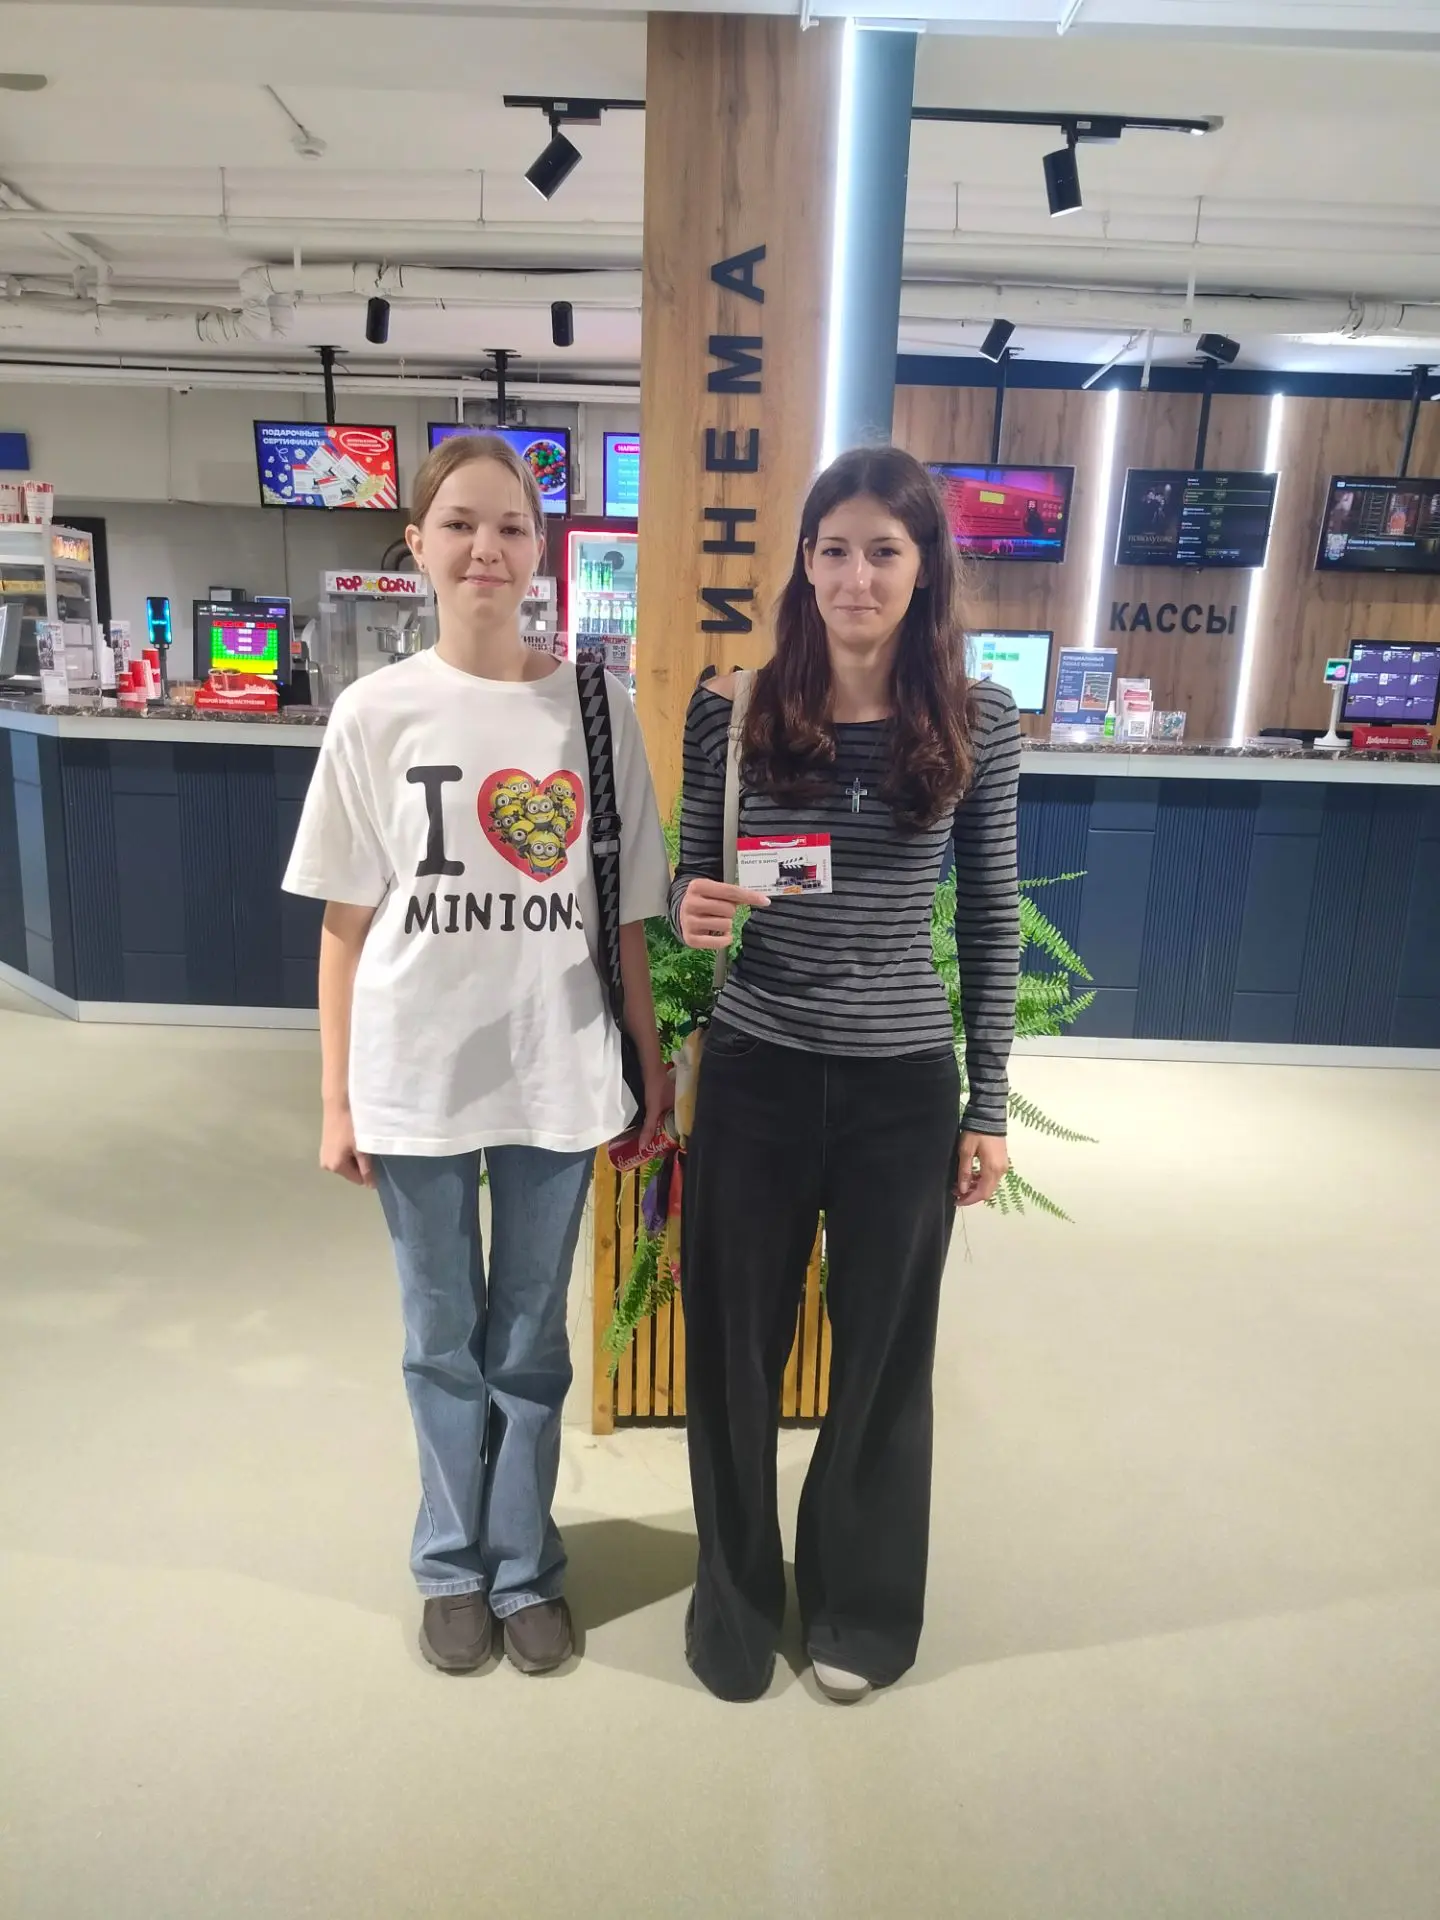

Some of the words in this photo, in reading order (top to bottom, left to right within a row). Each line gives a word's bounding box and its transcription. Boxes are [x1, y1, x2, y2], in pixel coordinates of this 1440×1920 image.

[262, 428, 320, 437] ПОДАРОЧНЫЕ
[263, 437, 325, 446] СЕРТИФИКАТЫ
[698, 244, 767, 685] ИНЕМА
[335, 576, 363, 592] POP
[378, 576, 416, 593] CORN
[1109, 601, 1238, 634] КАССЫ
[406, 765, 465, 877] I
